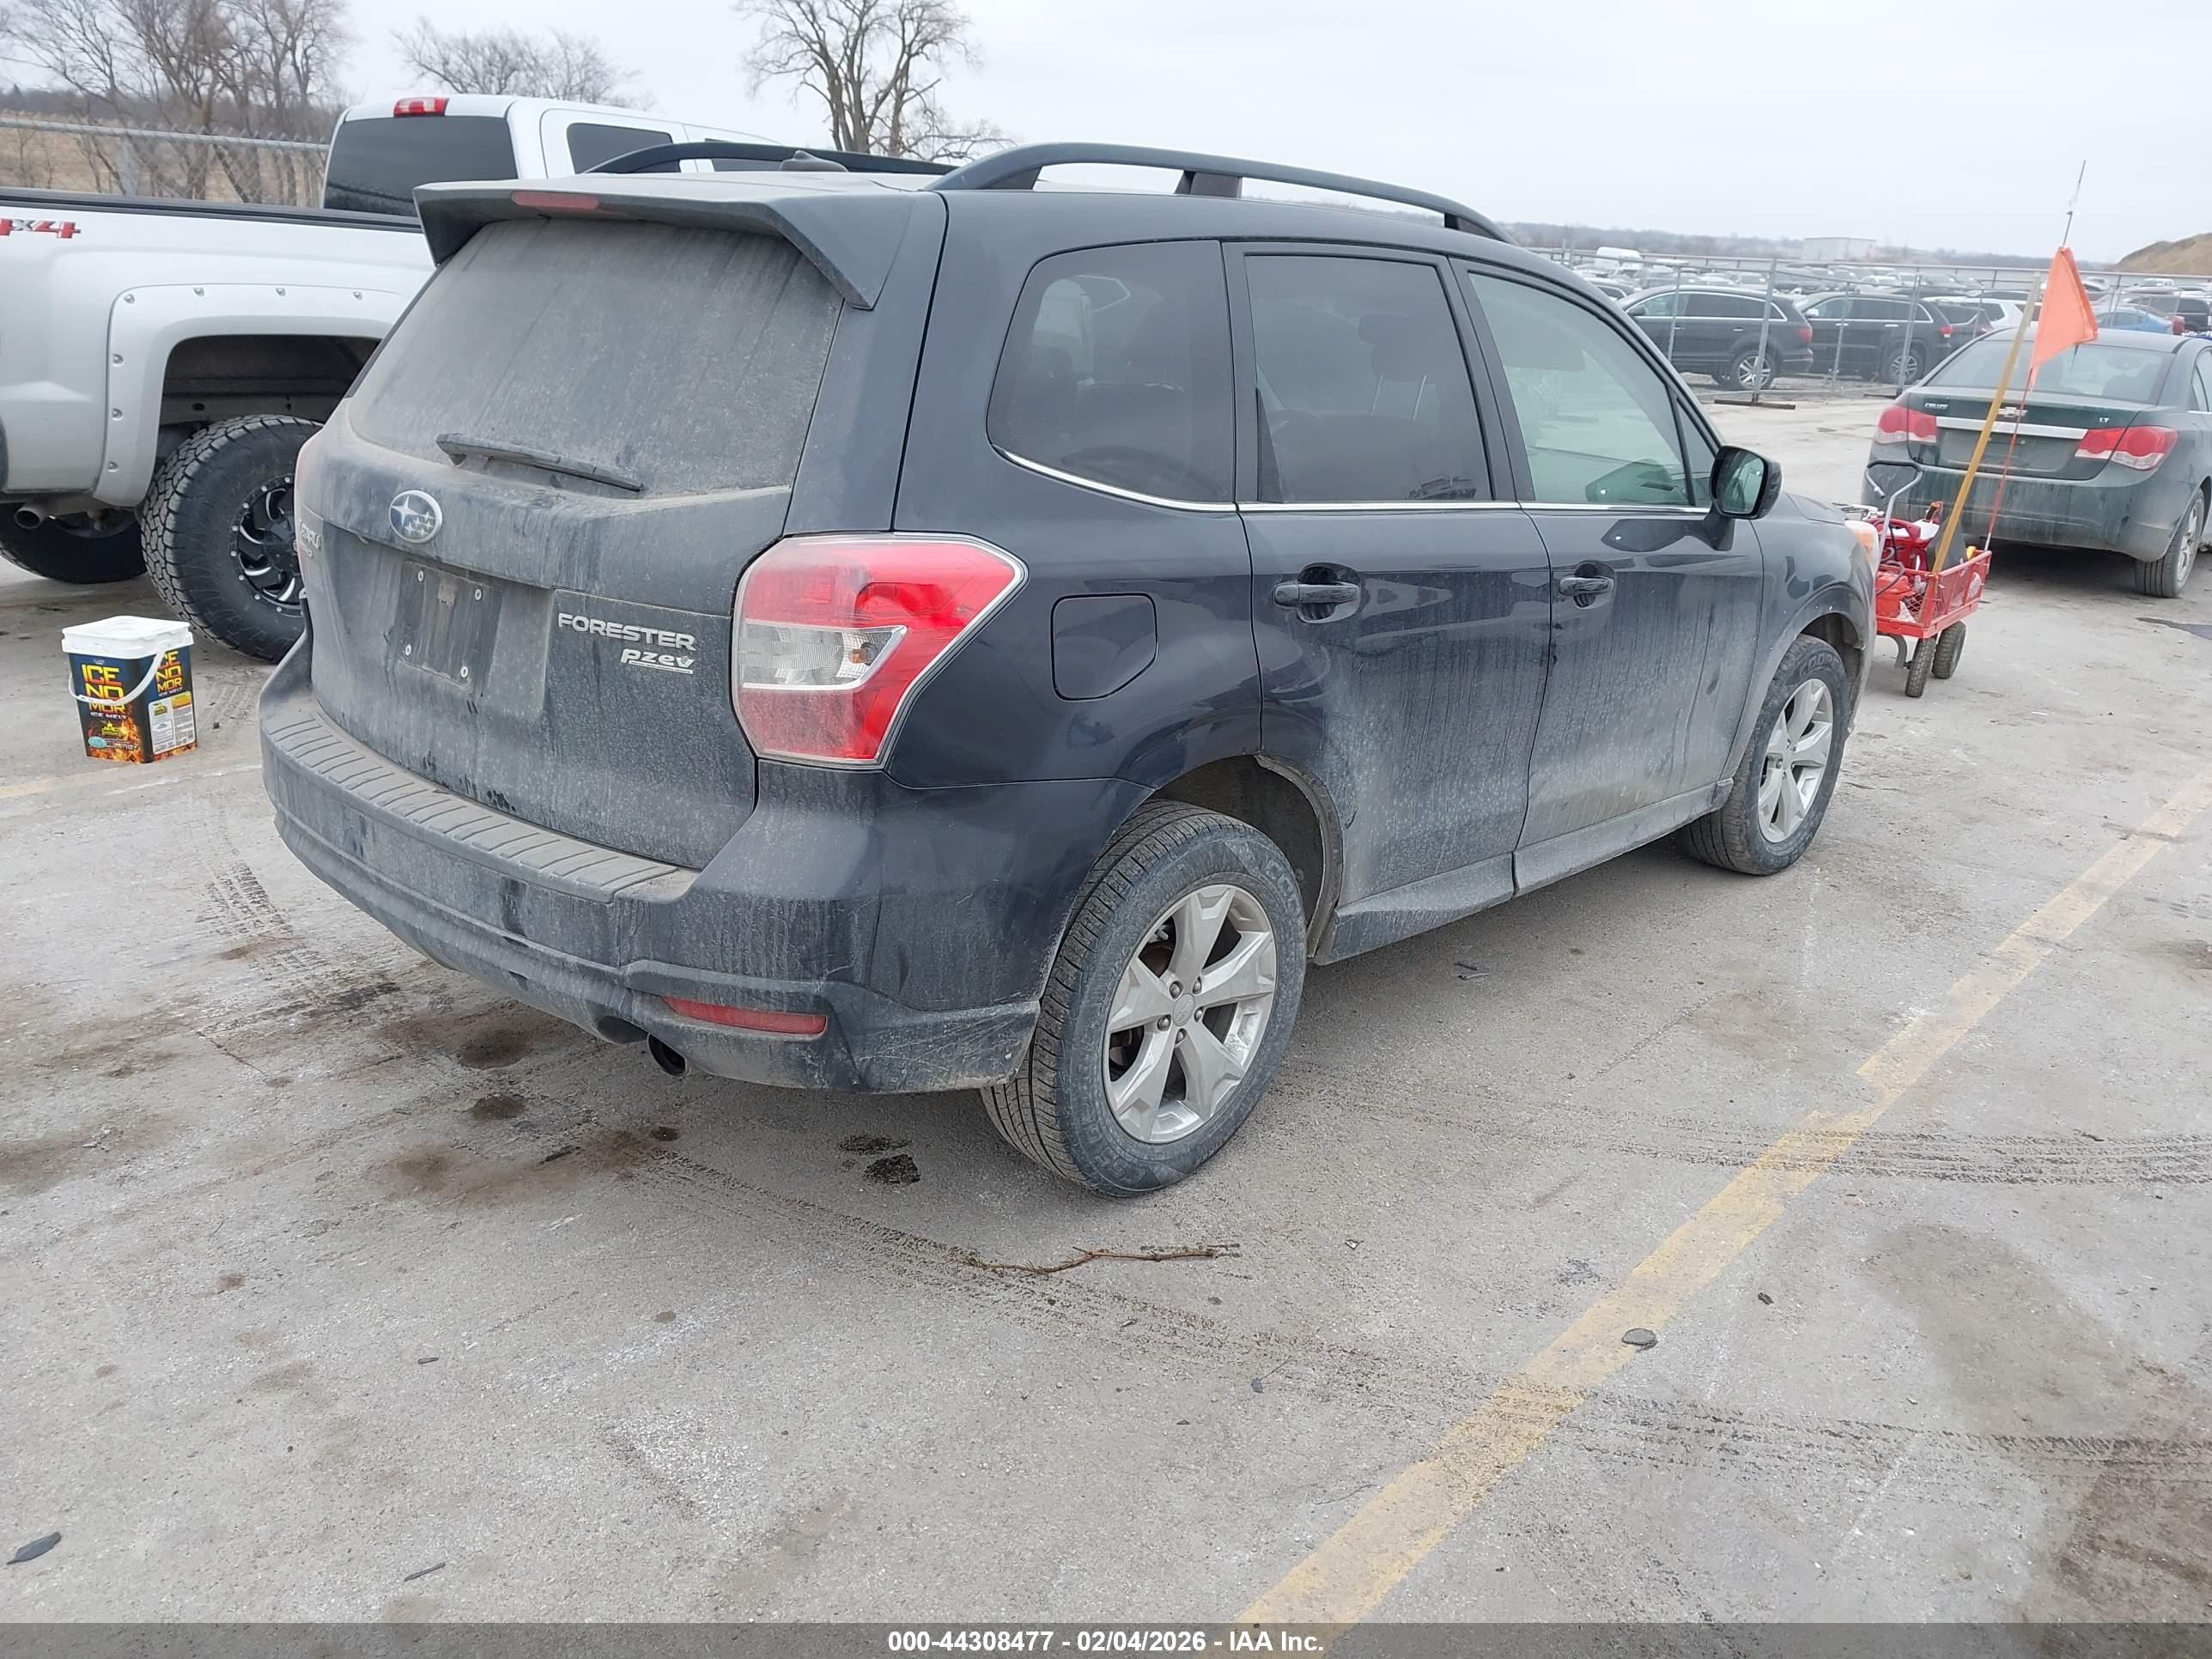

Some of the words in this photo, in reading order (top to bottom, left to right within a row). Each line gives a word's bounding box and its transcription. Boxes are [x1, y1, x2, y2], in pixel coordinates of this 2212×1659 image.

[558, 612, 698, 651] FORESTER
[158, 650, 180, 670] CE
[82, 664, 124, 687] ICE
[156, 665, 182, 683] NO
[85, 683, 125, 702] NO
[157, 678, 183, 694] MOR
[89, 702, 126, 714] MOR
